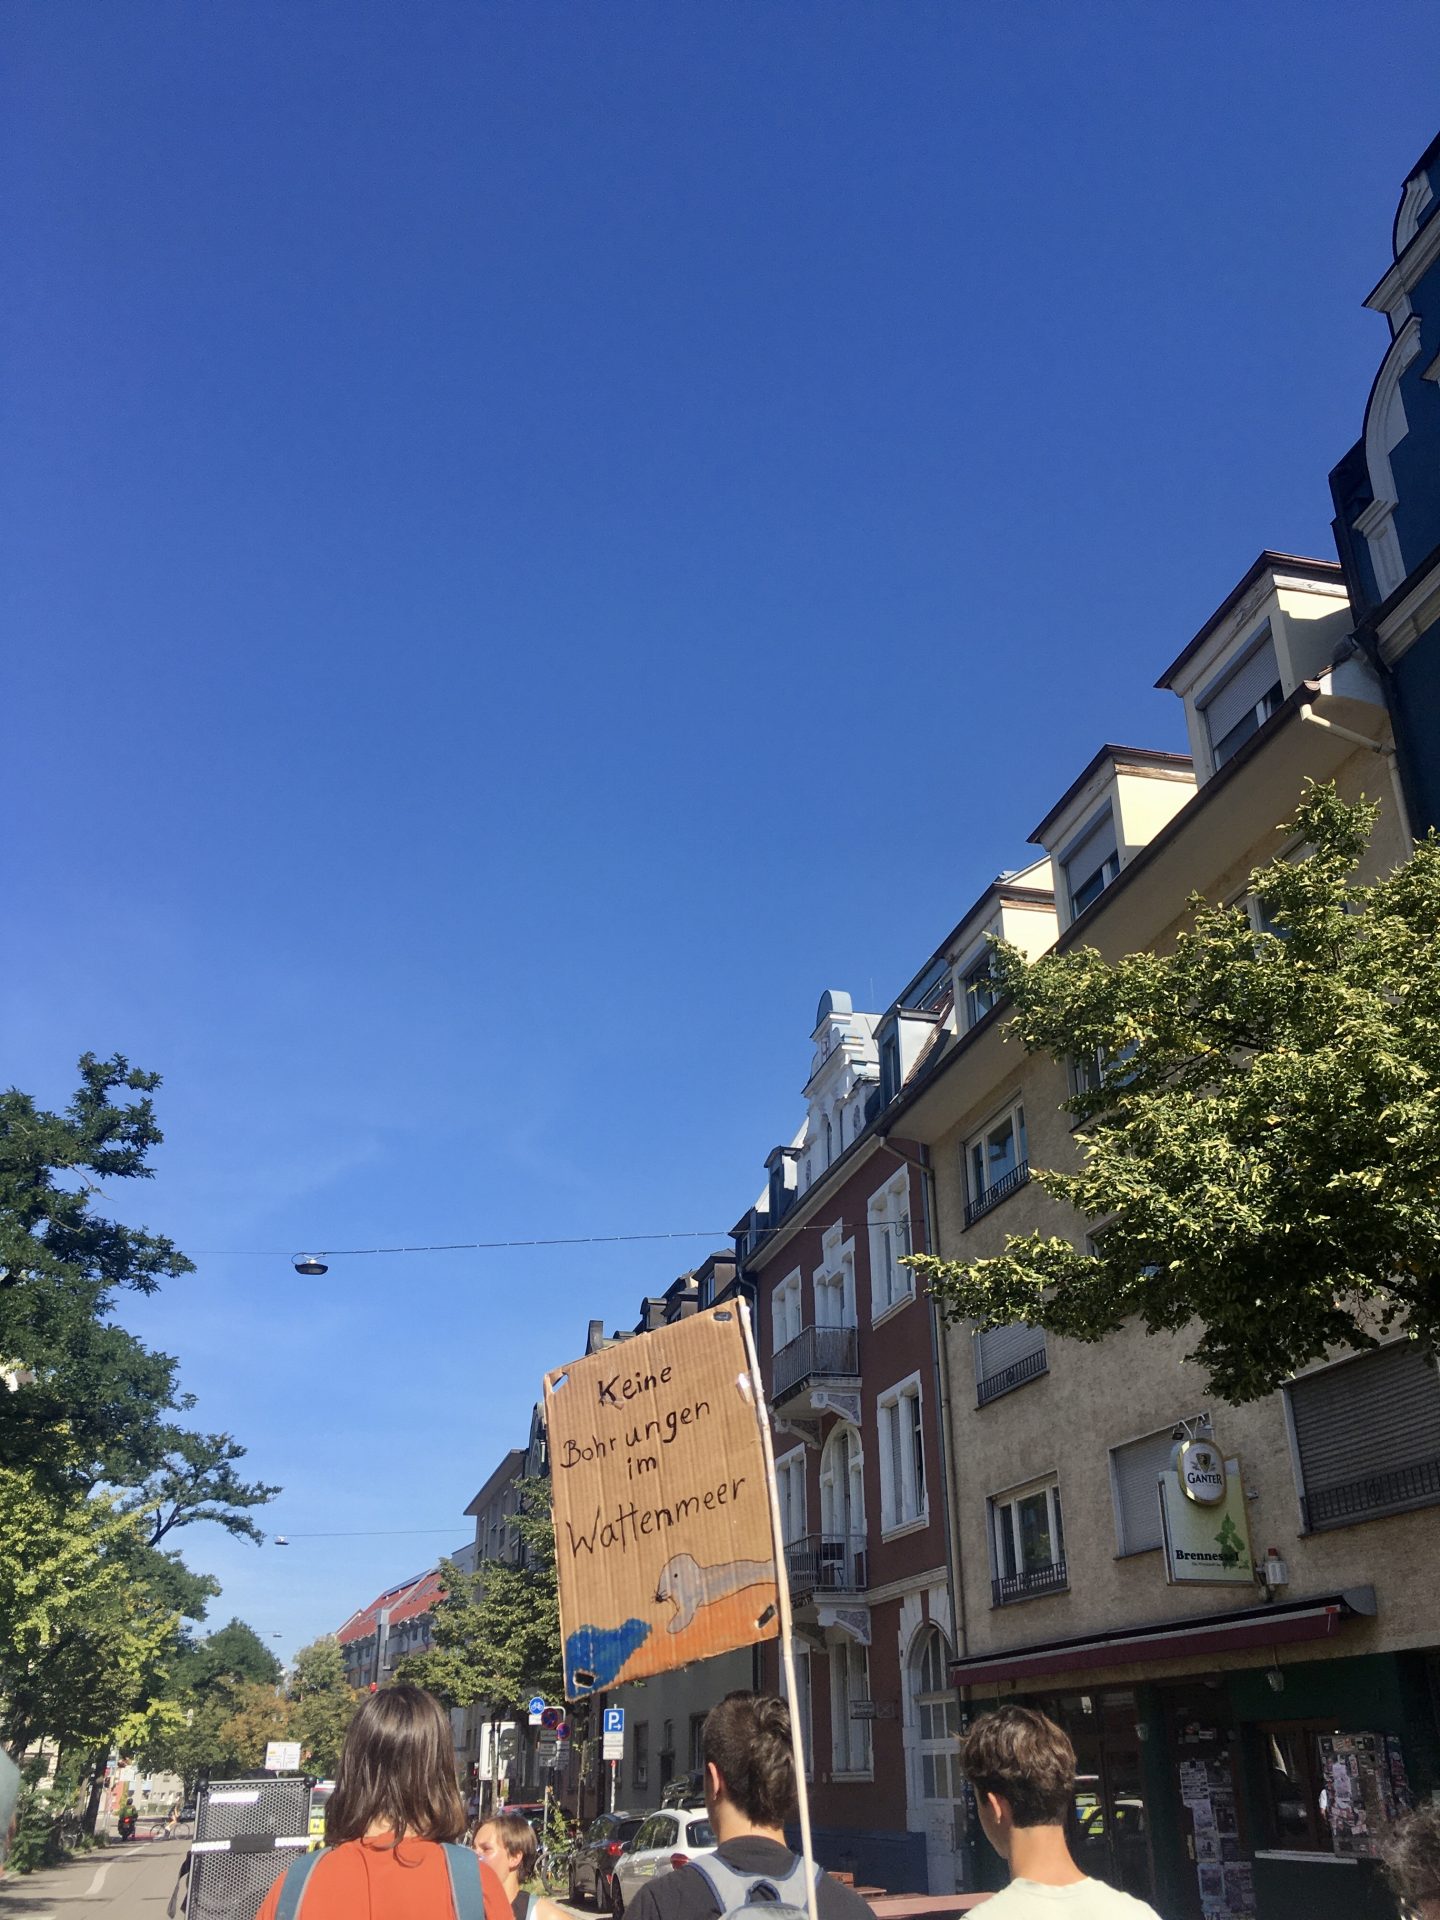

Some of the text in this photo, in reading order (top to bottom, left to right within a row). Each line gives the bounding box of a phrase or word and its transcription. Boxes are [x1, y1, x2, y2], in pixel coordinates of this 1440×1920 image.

[598, 1366, 672, 1406] Keine
[561, 1401, 710, 1468] Bohrungen
[628, 1456, 657, 1480] im
[1187, 1472, 1222, 1485] GANTER
[567, 1477, 746, 1558] Wattenmeer
[608, 1711, 620, 1730] P
